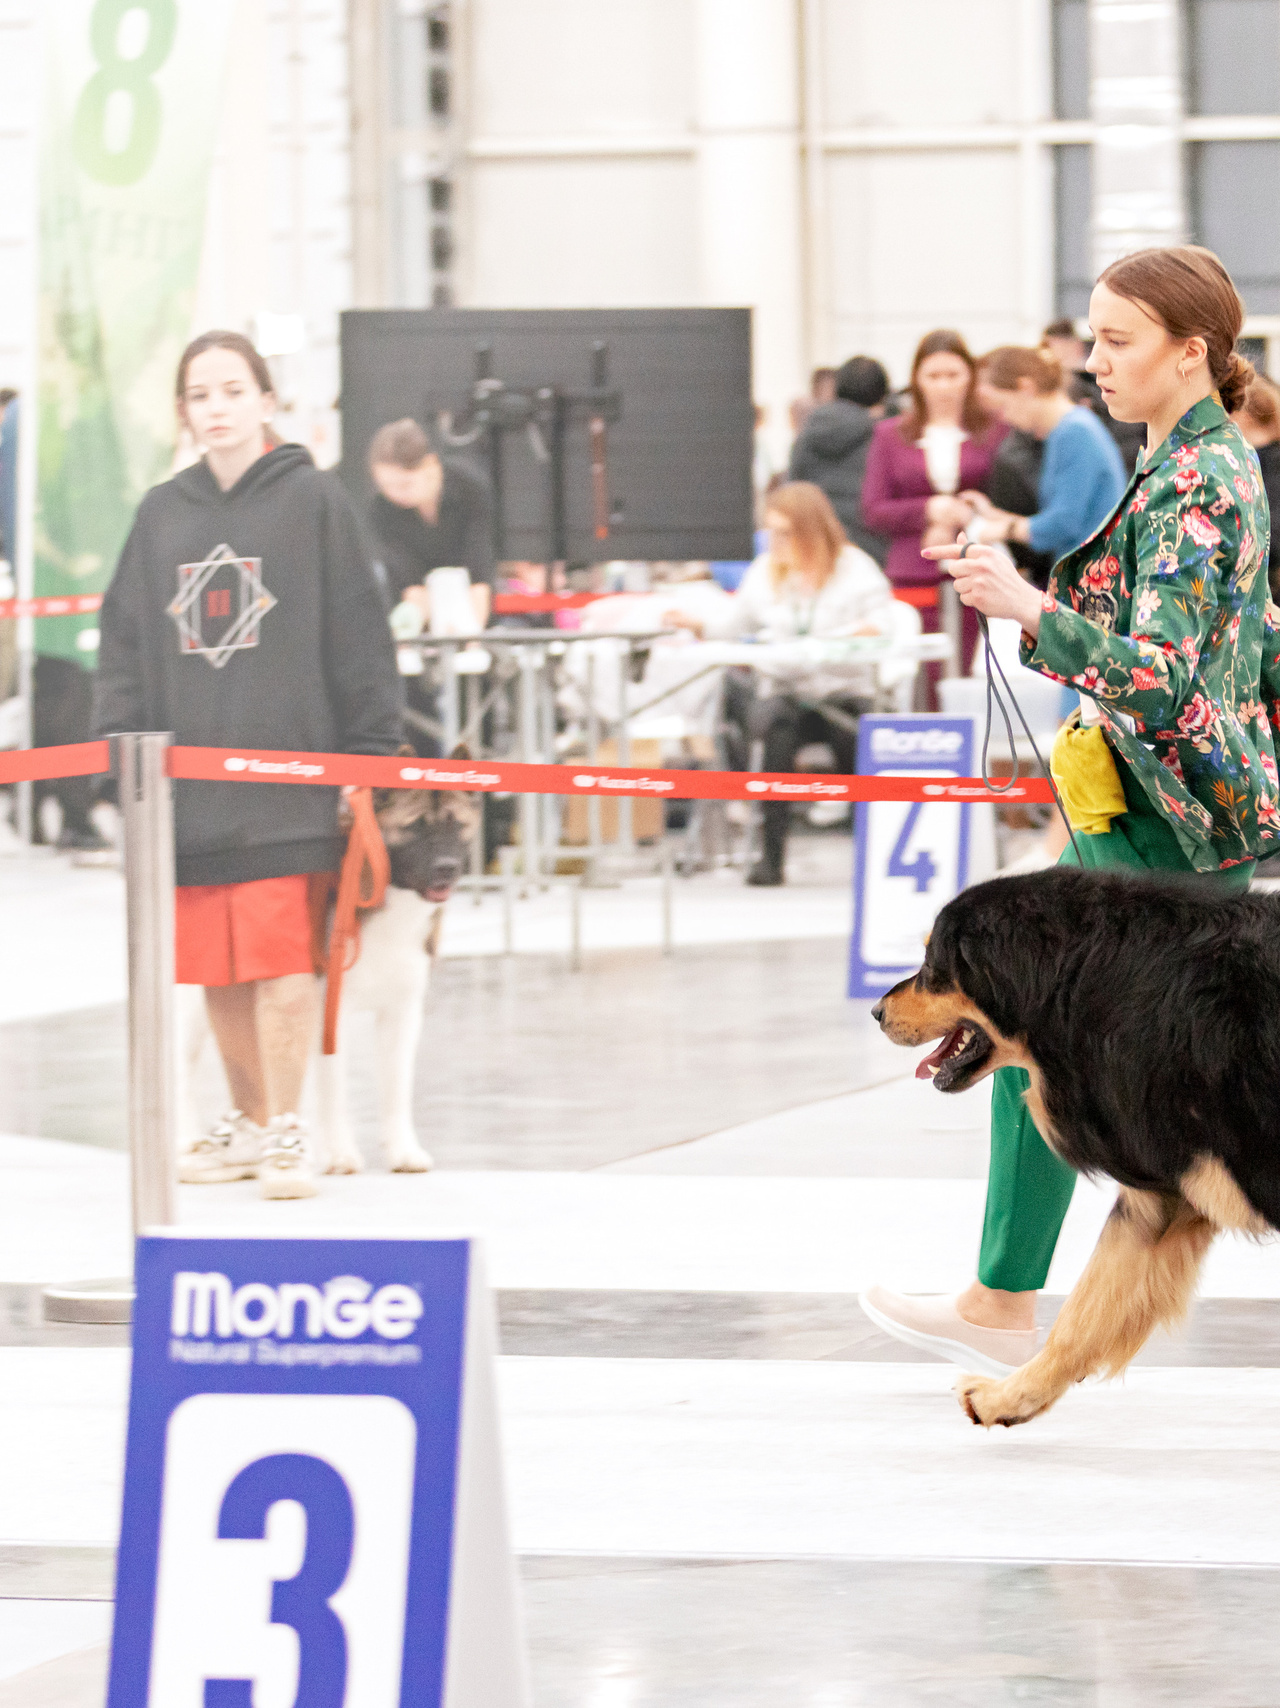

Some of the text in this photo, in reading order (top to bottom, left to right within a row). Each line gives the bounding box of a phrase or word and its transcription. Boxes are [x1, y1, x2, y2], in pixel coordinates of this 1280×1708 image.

[72, 0, 178, 186] 8
[886, 801, 937, 893] 4
[202, 1453, 356, 1708] 3
